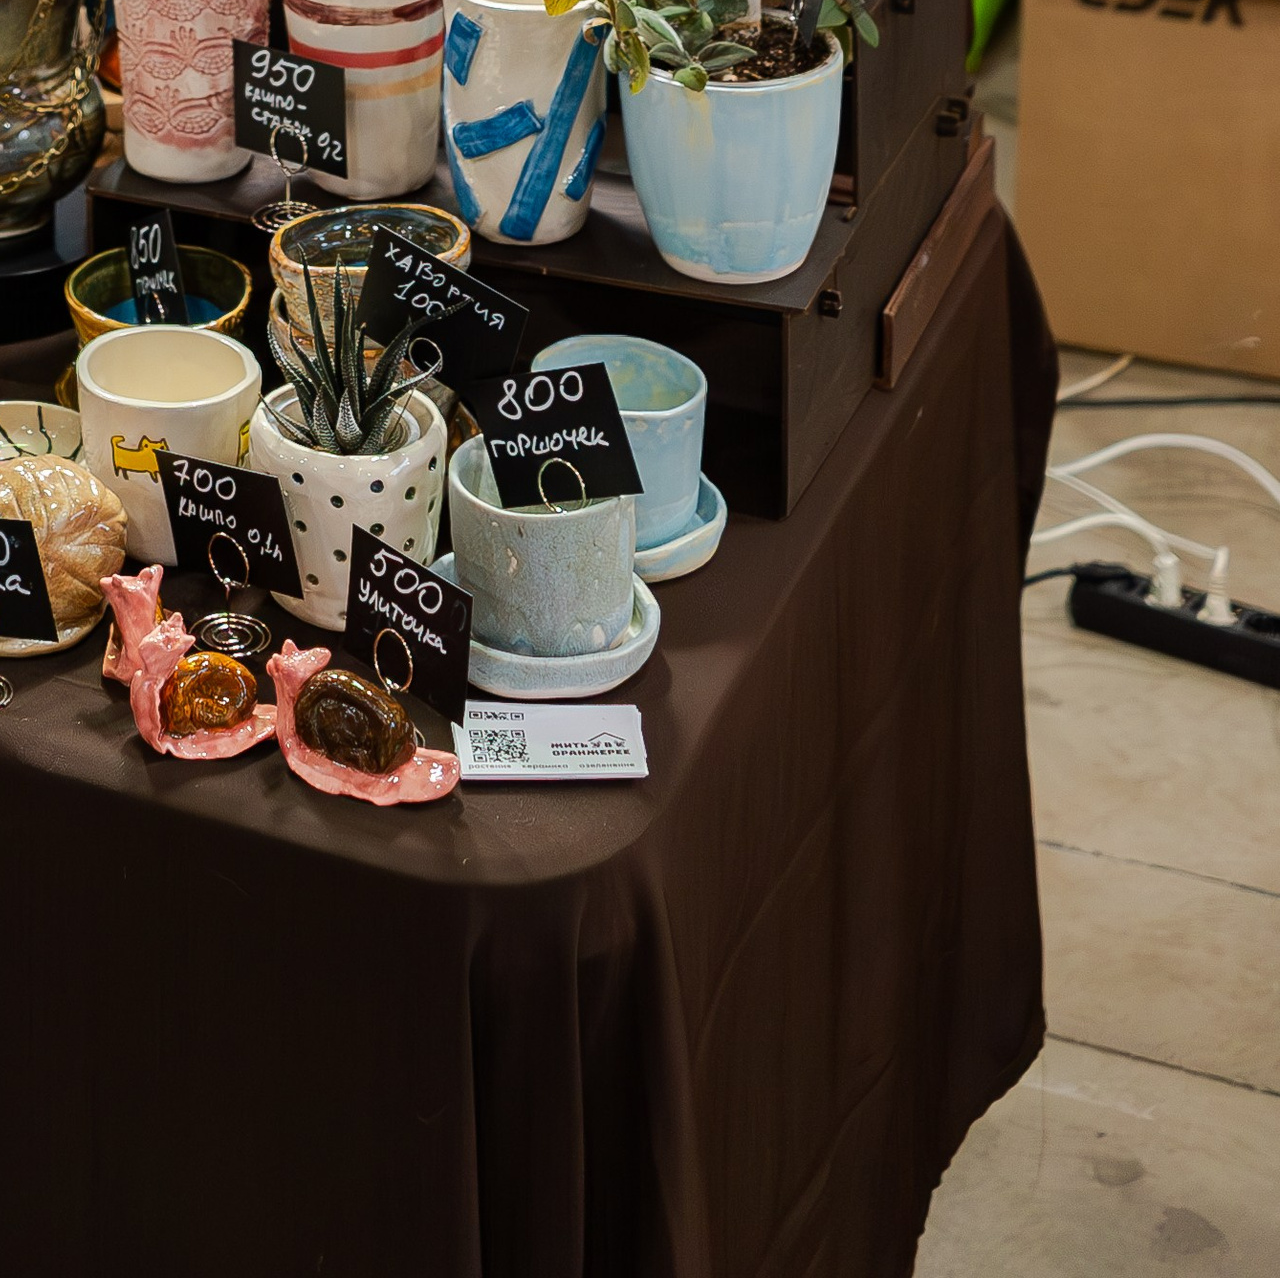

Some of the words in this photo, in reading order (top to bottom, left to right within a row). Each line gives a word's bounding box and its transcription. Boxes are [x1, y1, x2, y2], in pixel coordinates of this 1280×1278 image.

[251, 50, 315, 92] 950
[130, 224, 161, 270] 850
[497, 370, 584, 421] 800
[173, 459, 237, 501] 700
[370, 548, 443, 614] 500
